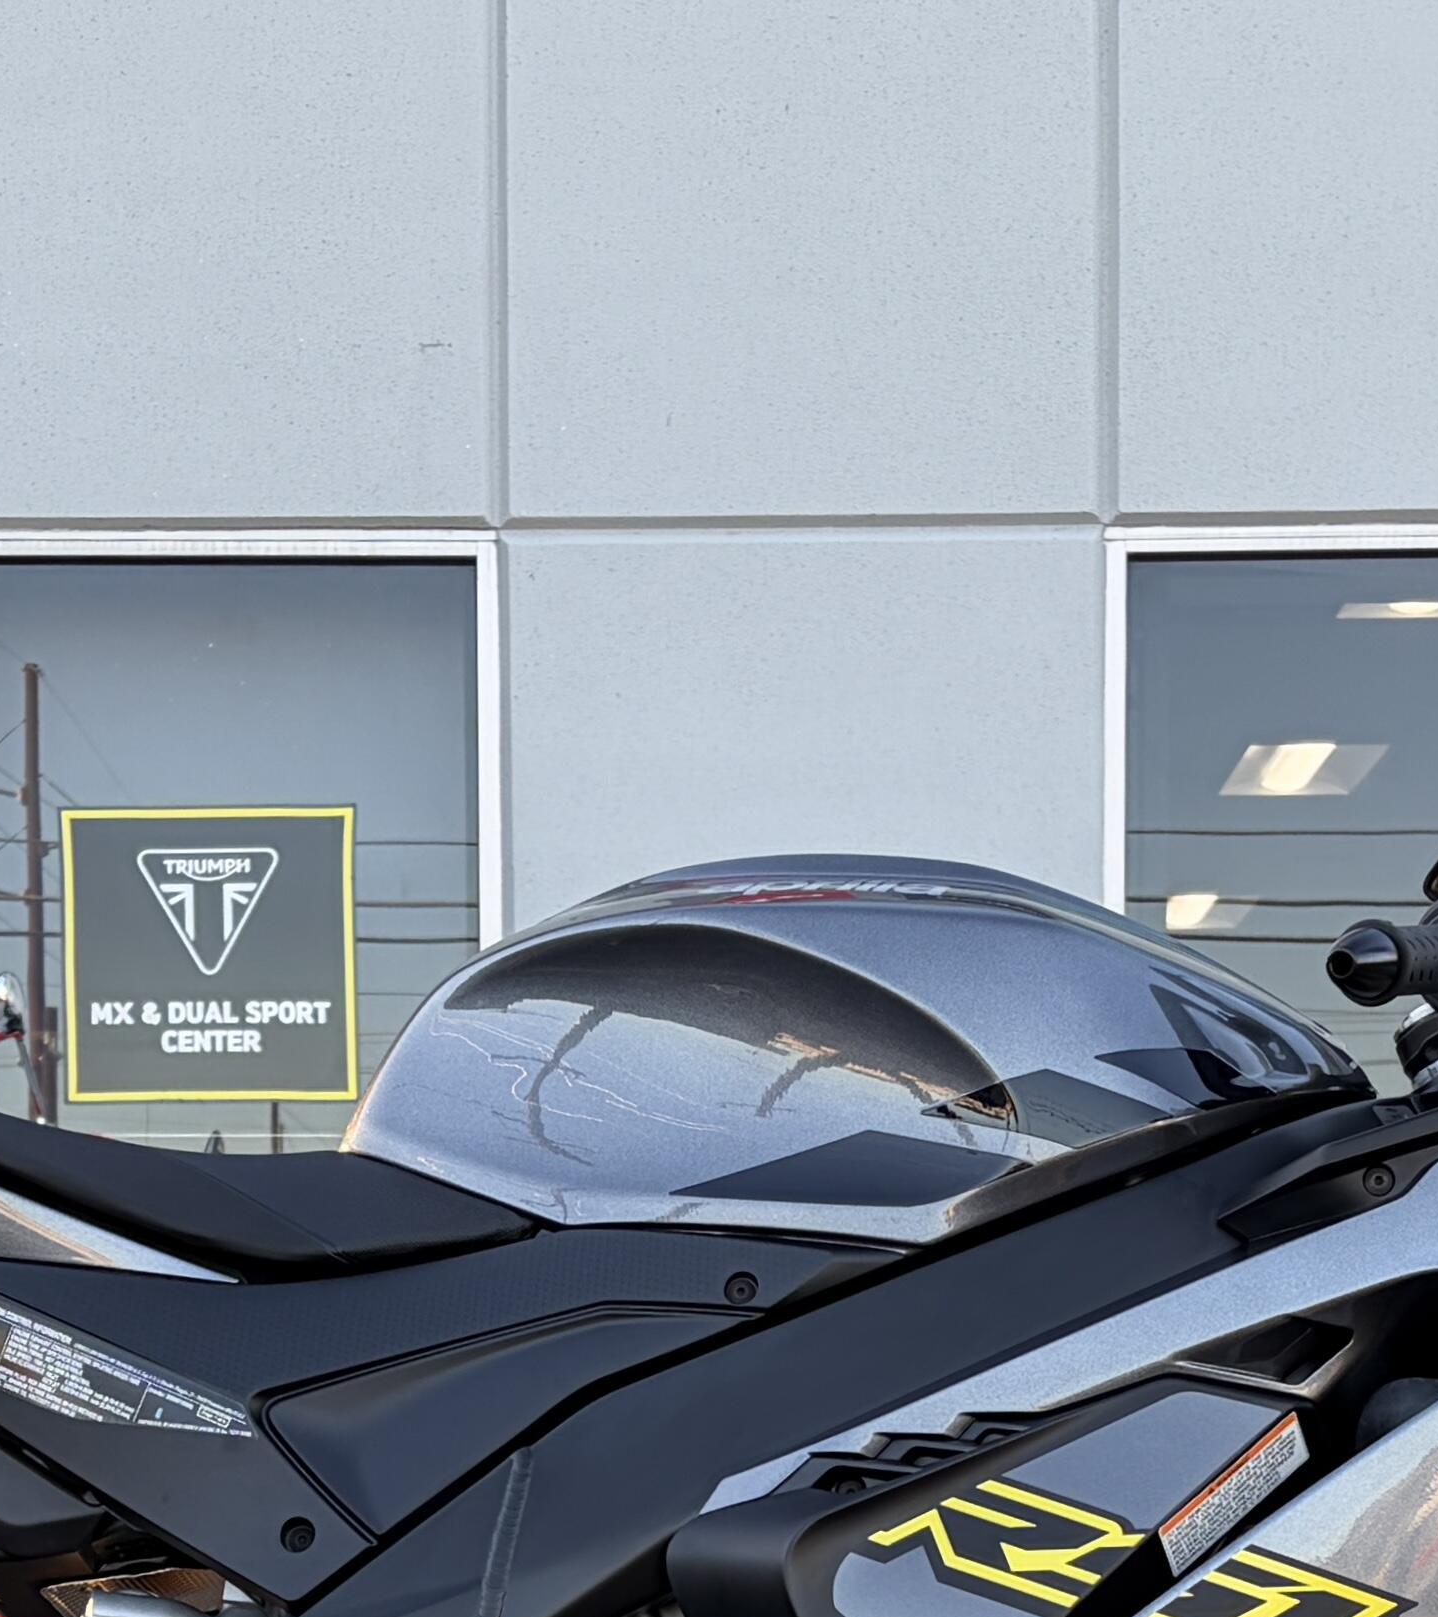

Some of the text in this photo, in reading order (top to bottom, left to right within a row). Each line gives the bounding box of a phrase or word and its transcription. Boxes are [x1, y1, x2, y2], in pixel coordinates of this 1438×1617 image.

[163, 858, 251, 879] TRIUMPH
[91, 1001, 331, 1025] MX & DUAL SPORT
[161, 1029, 262, 1053] CENTER
